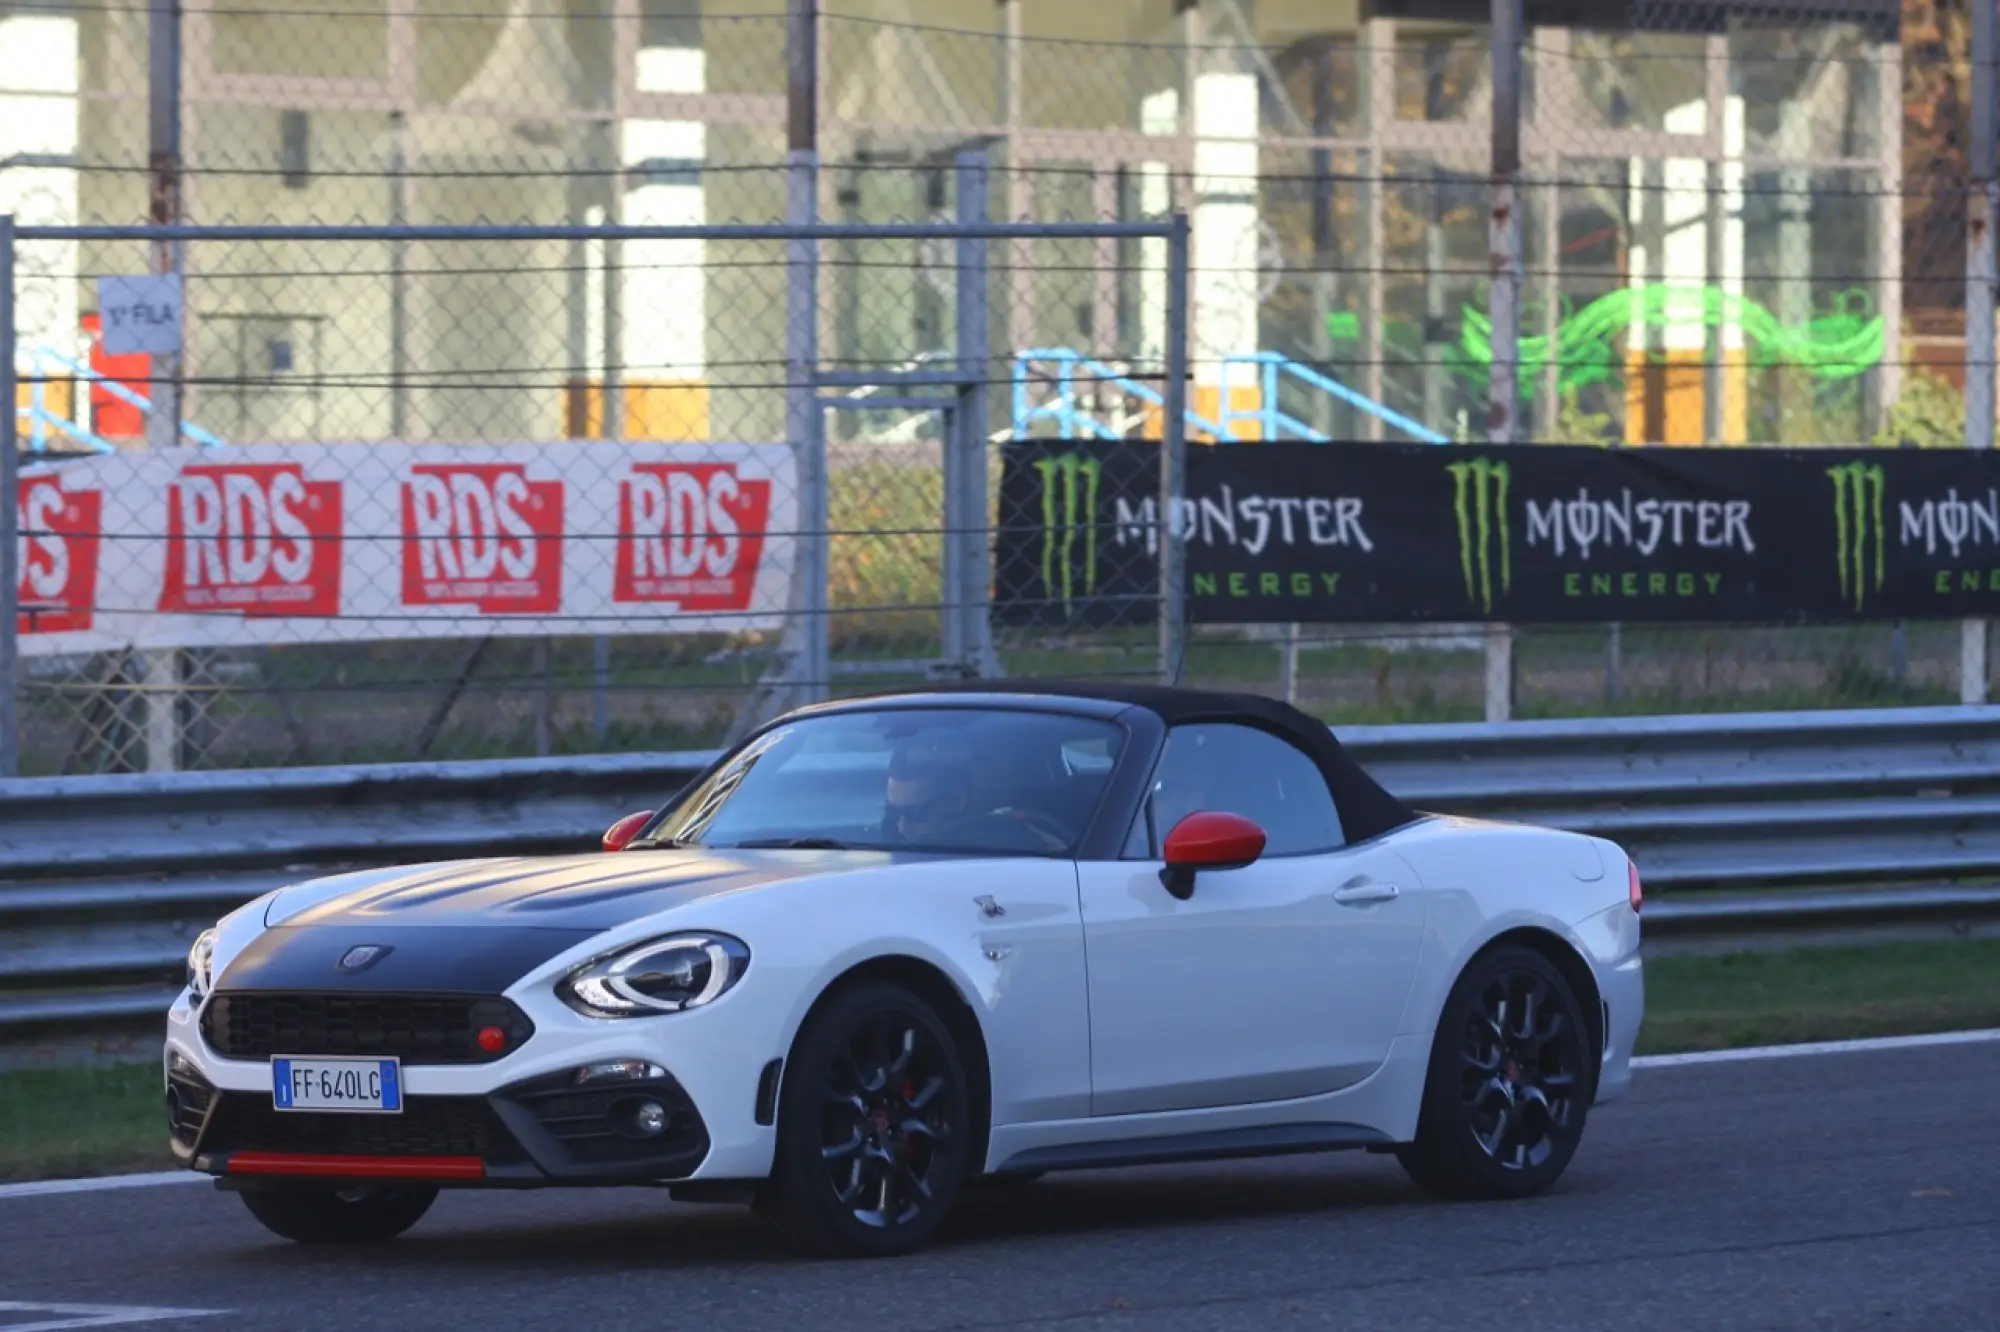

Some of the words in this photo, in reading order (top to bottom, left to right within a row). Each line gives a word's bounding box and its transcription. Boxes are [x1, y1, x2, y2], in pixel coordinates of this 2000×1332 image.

[180, 471, 314, 586] RDS
[410, 471, 537, 580] RDS
[632, 470, 739, 578] RDS
[1526, 488, 1756, 560] MONSTER
[1193, 572, 1341, 596] NERGY
[1564, 572, 1723, 597] ENERGY
